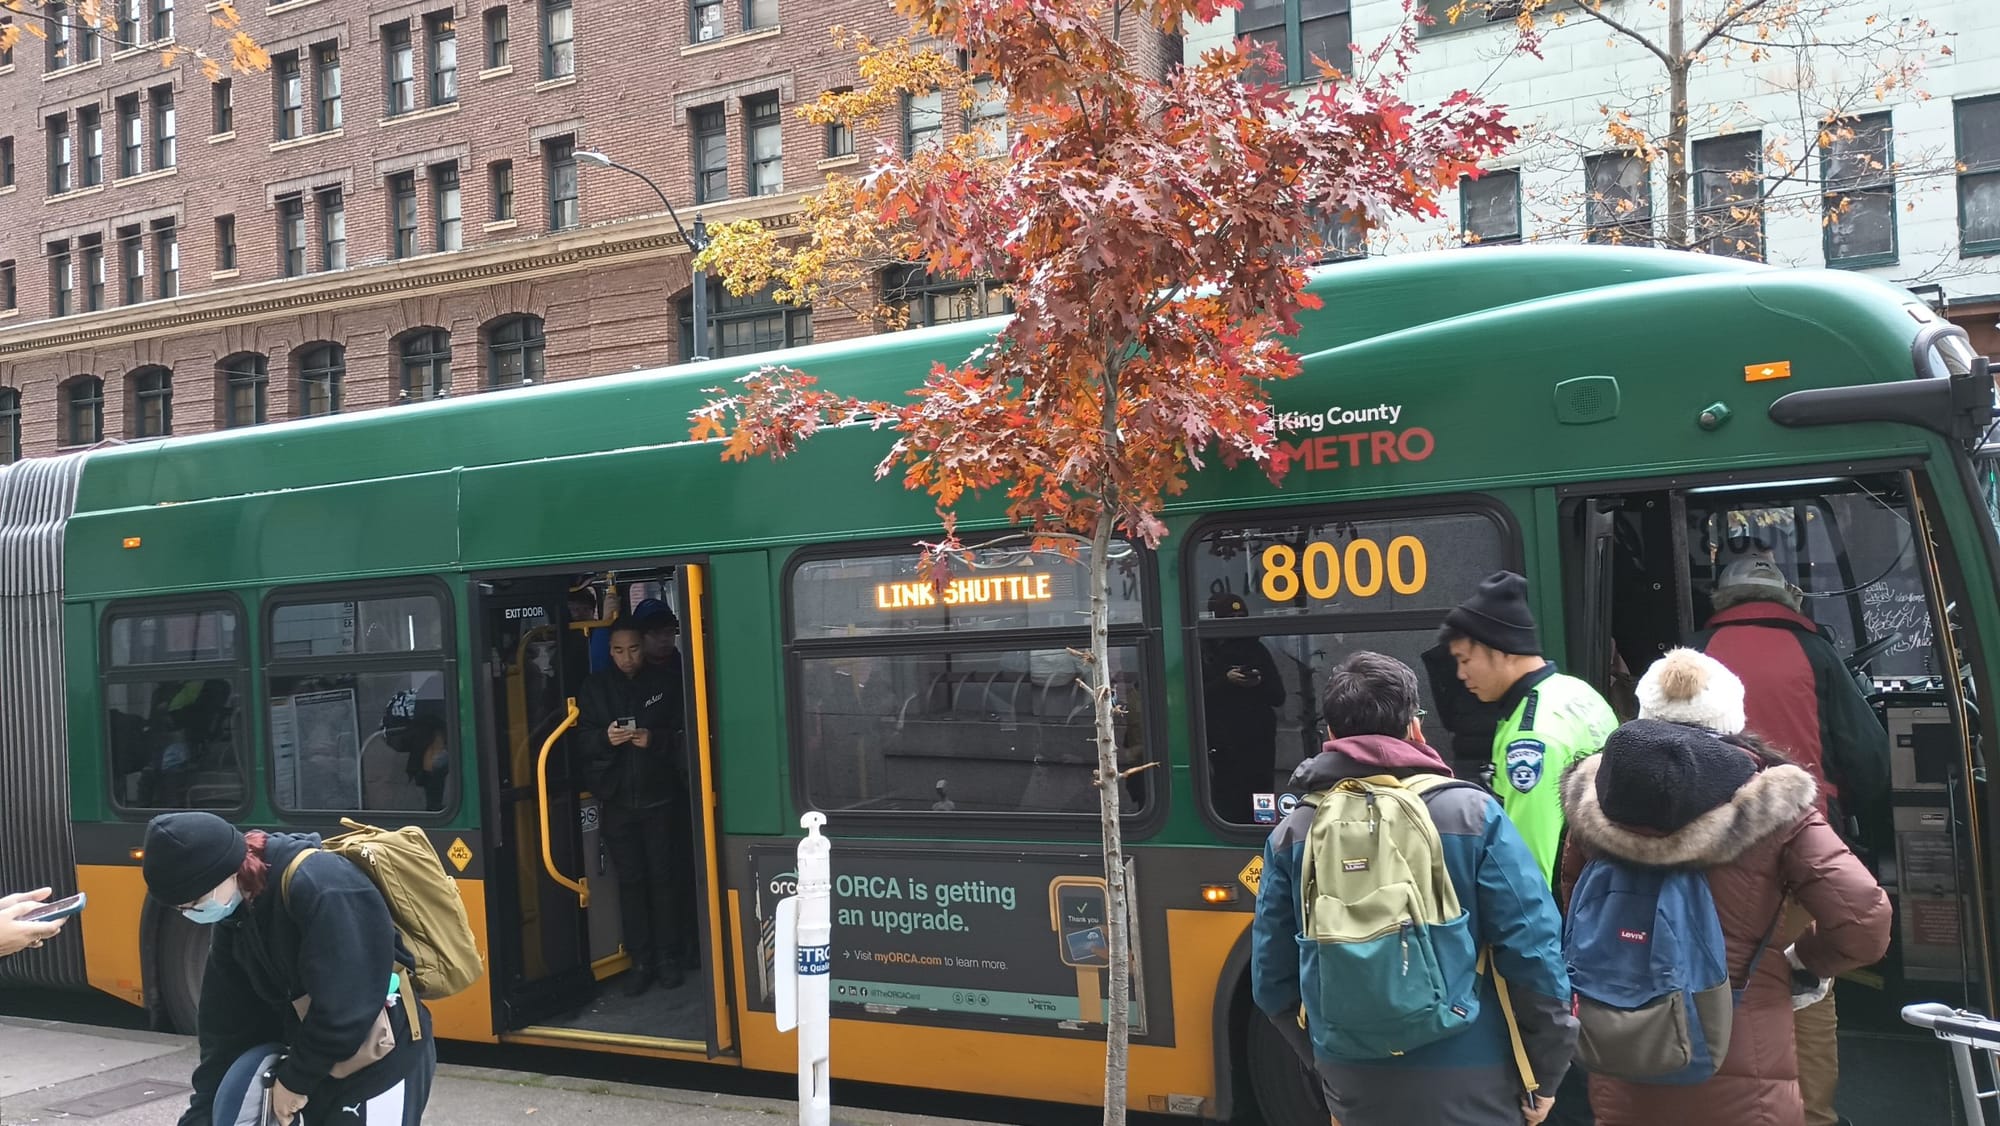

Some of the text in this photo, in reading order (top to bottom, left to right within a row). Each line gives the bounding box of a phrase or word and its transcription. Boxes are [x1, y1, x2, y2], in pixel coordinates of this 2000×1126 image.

[1279, 403, 1402, 432] King County
[1279, 427, 1435, 471] METRO
[1262, 535, 1428, 602] 8000
[878, 574, 1051, 609] LINK SHUTTLE
[505, 606, 543, 619] EXIT DOOR
[769, 880, 797, 896] orc
[836, 874, 1016, 910] ORCA is getting
[838, 908, 969, 934] an upgrade.
[1067, 914, 1100, 925] Thank you
[854, 950, 1008, 970] Visit myORCA.com to learn more.
